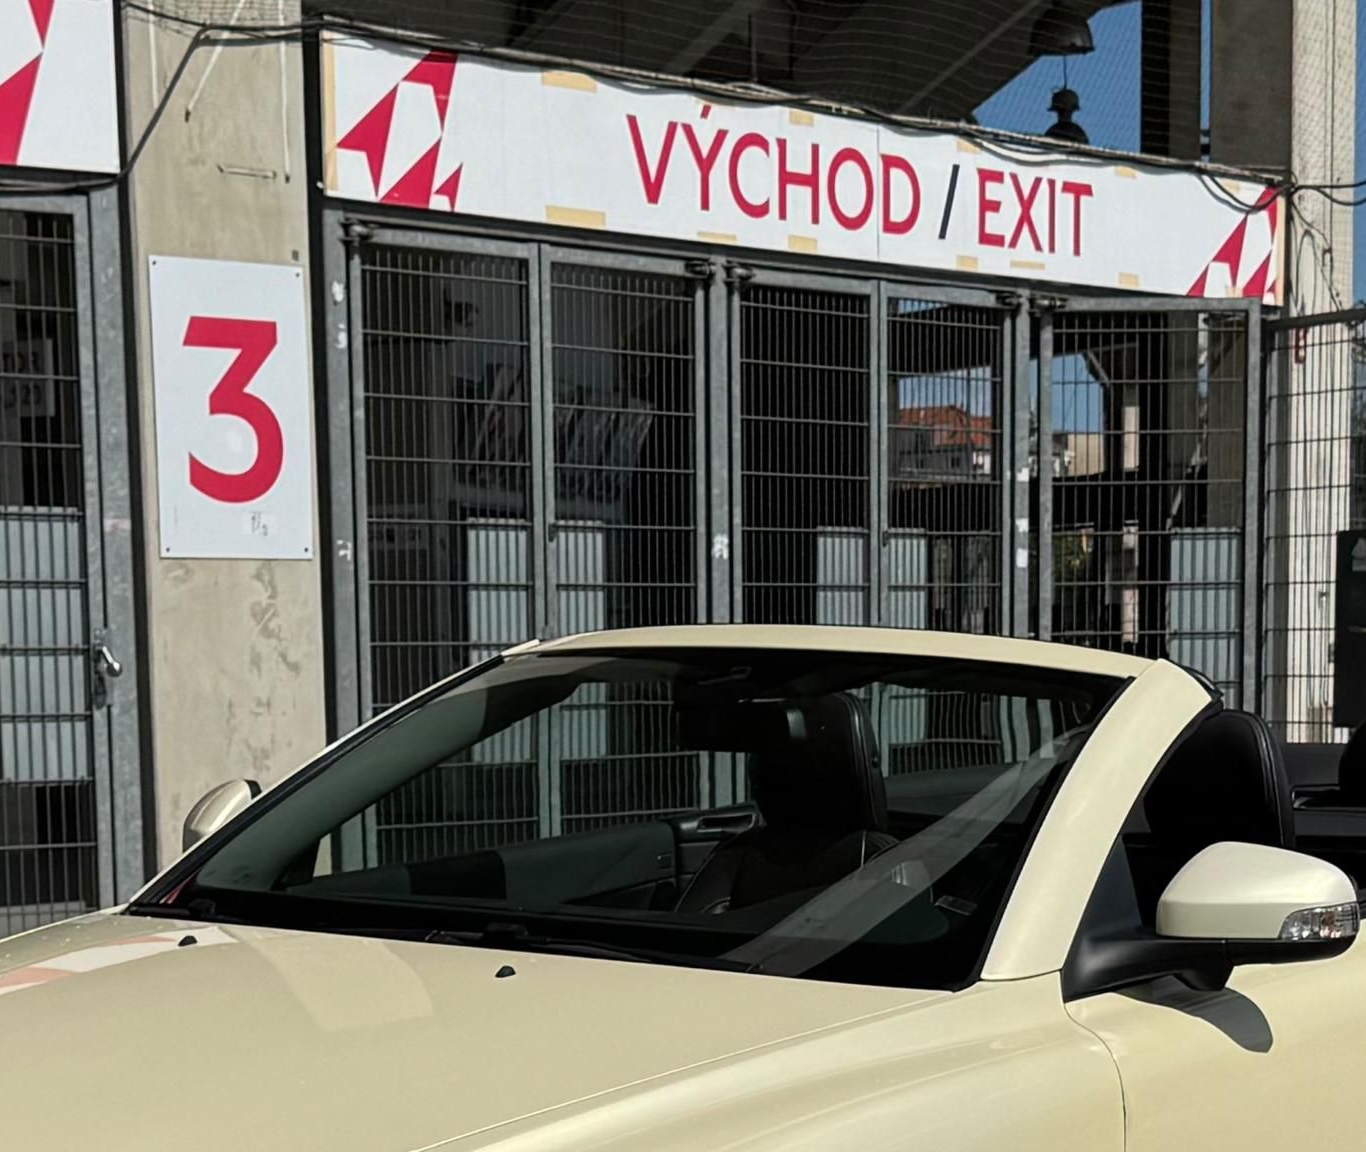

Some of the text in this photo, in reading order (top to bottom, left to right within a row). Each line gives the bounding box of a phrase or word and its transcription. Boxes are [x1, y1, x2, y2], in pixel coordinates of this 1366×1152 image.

[626, 104, 921, 235] VÝCHOD
[976, 167, 1094, 257] EXIT
[182, 315, 284, 503] 3
